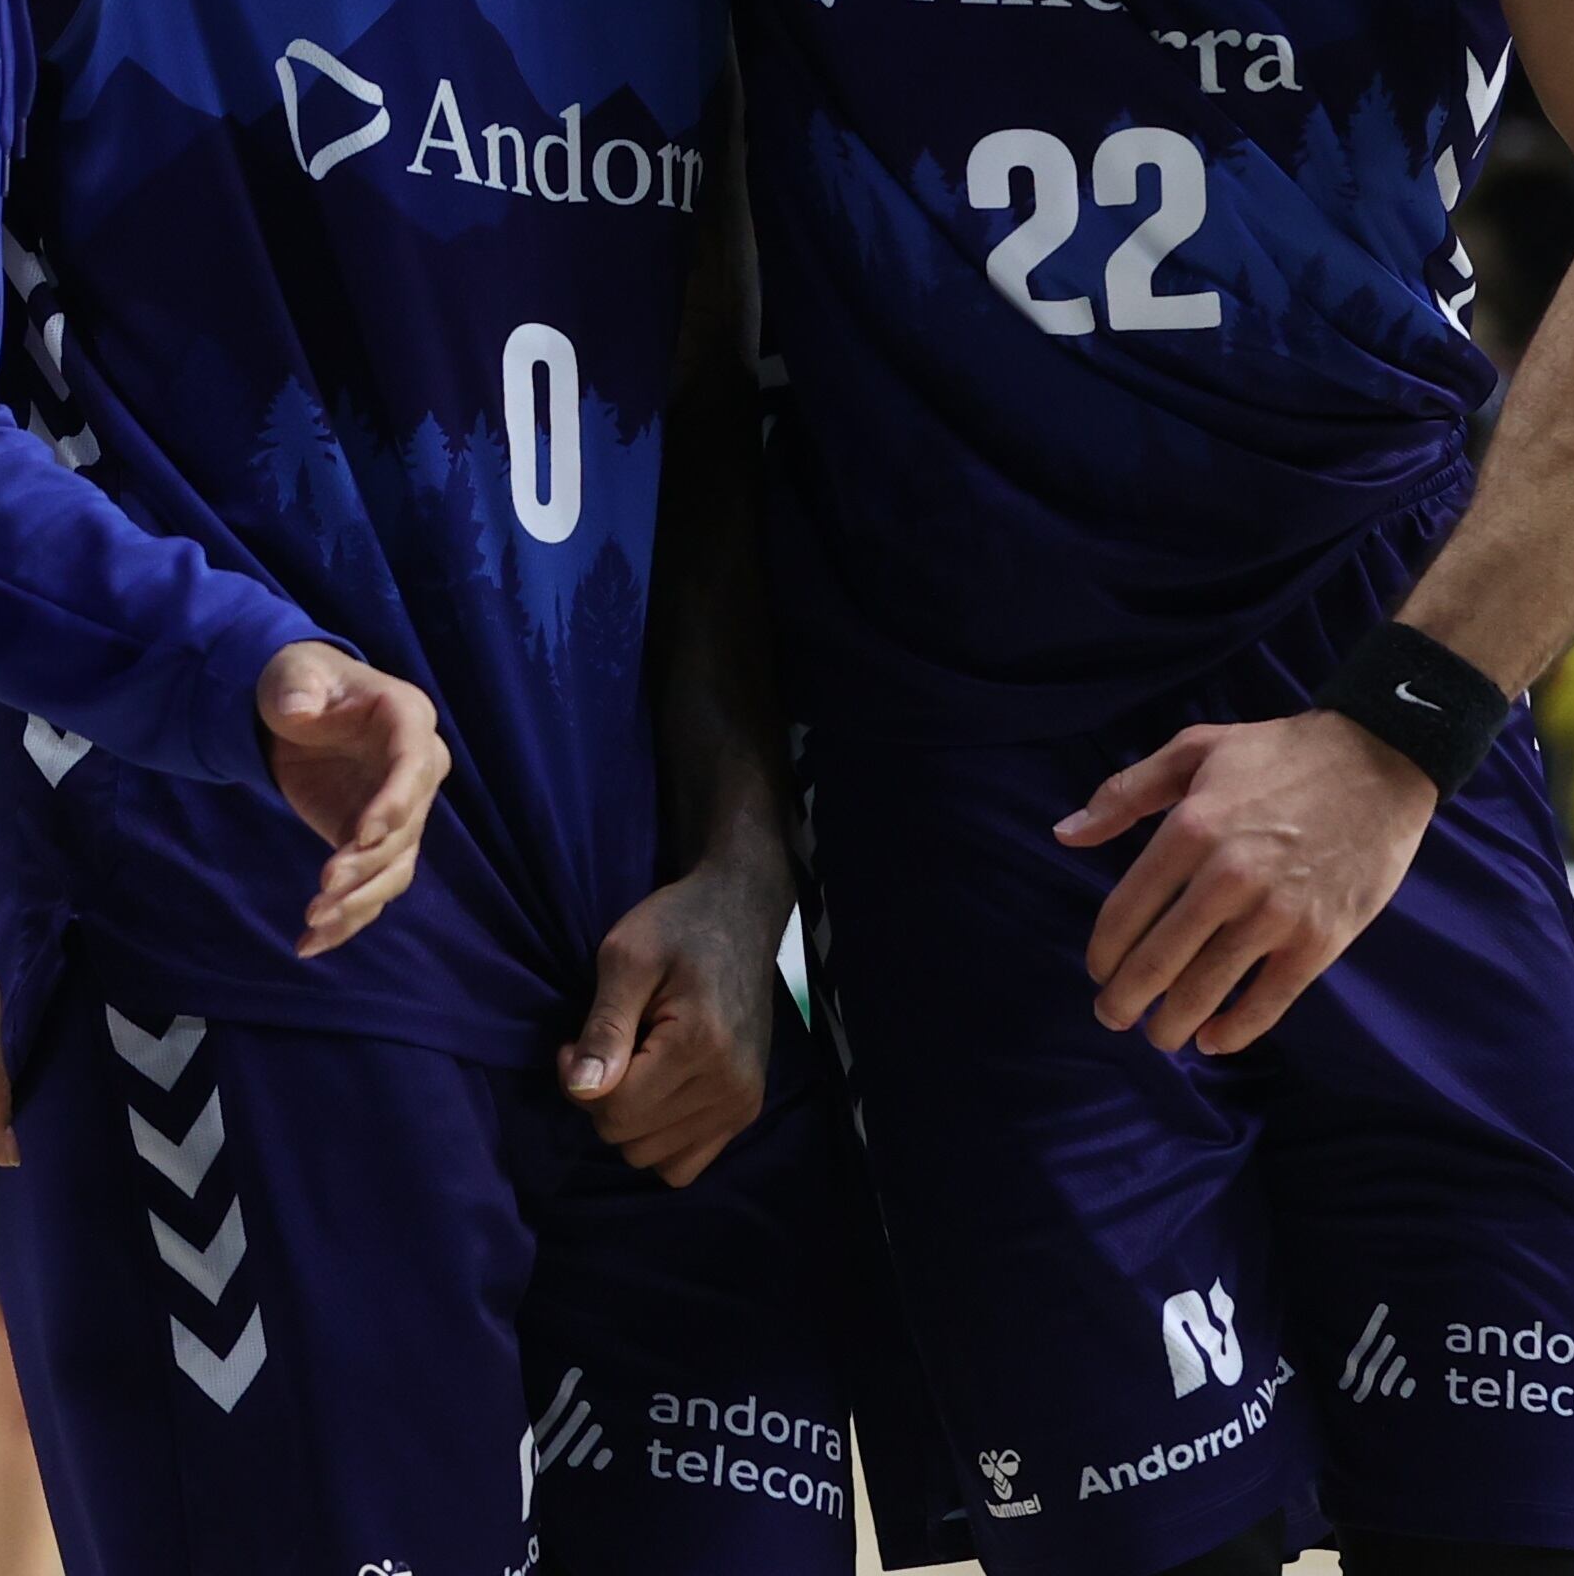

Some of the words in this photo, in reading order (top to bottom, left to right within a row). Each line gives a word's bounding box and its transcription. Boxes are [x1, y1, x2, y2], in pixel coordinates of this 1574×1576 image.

[966, 127, 1222, 336] 22
[503, 322, 581, 543] 0
[648, 1393, 841, 1461] andorra
[1078, 1418, 1244, 1501] Andorra
[1241, 1400, 1268, 1436] la
[647, 1438, 843, 1520] telecom
